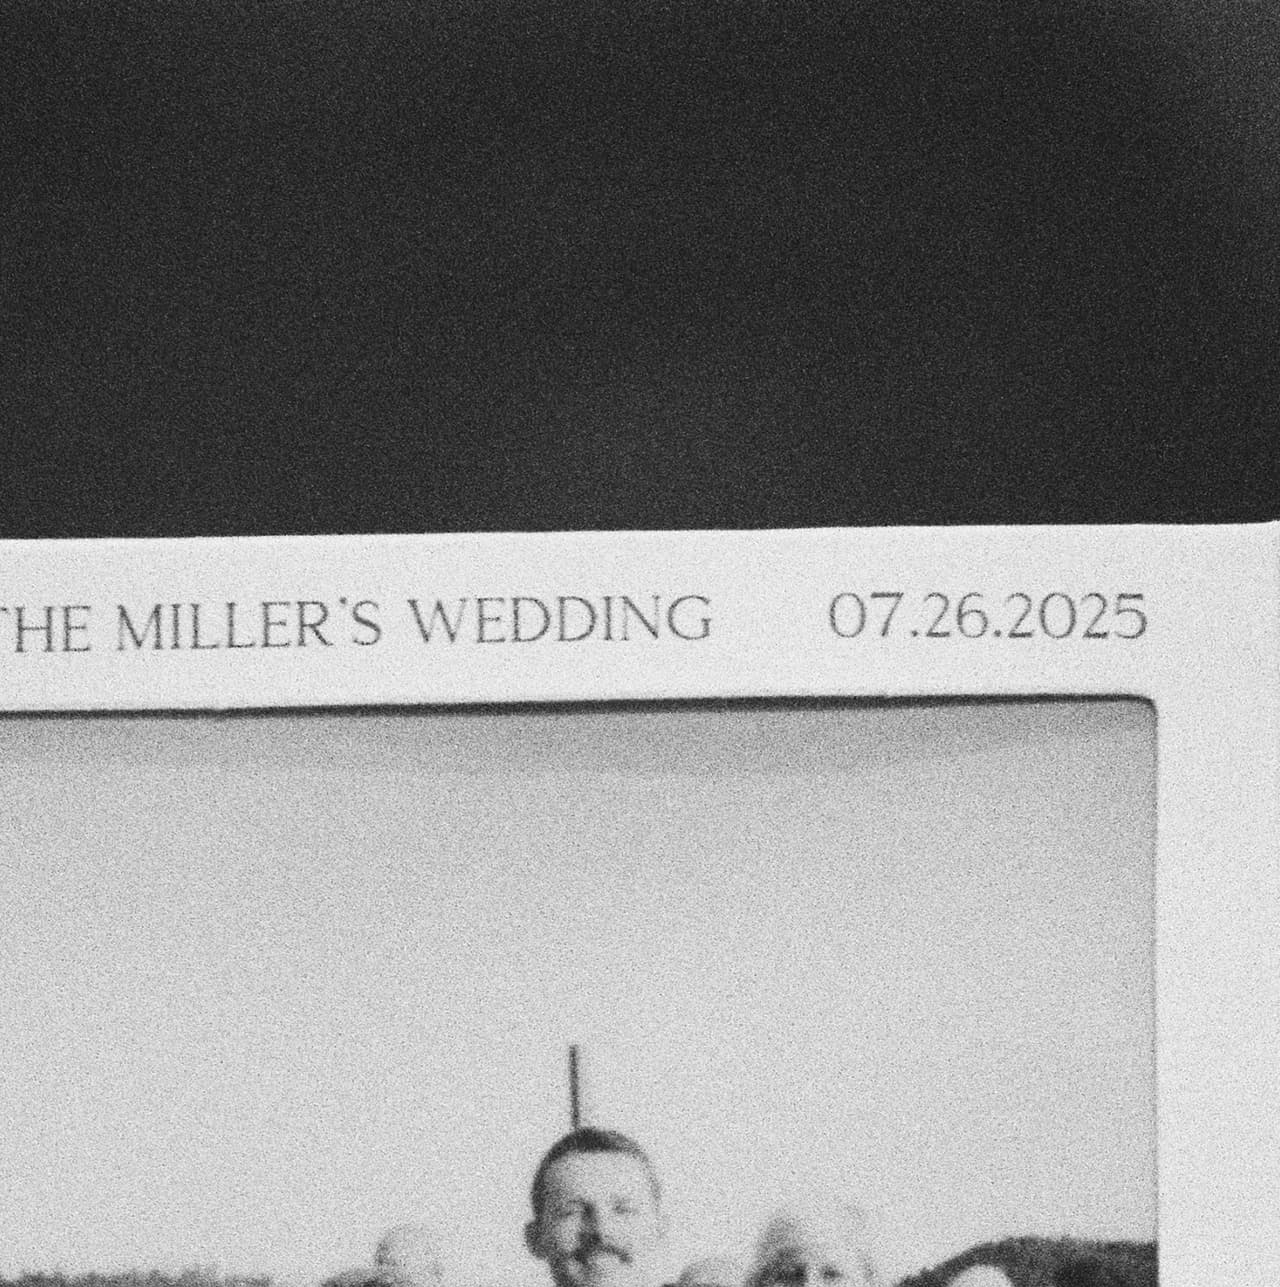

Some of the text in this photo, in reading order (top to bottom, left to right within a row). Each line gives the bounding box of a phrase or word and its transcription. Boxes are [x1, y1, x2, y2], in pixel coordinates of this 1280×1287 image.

[117, 595, 384, 652] MILLER'S
[407, 594, 713, 645] WEDDING
[827, 591, 1150, 641] 07.26.2025
